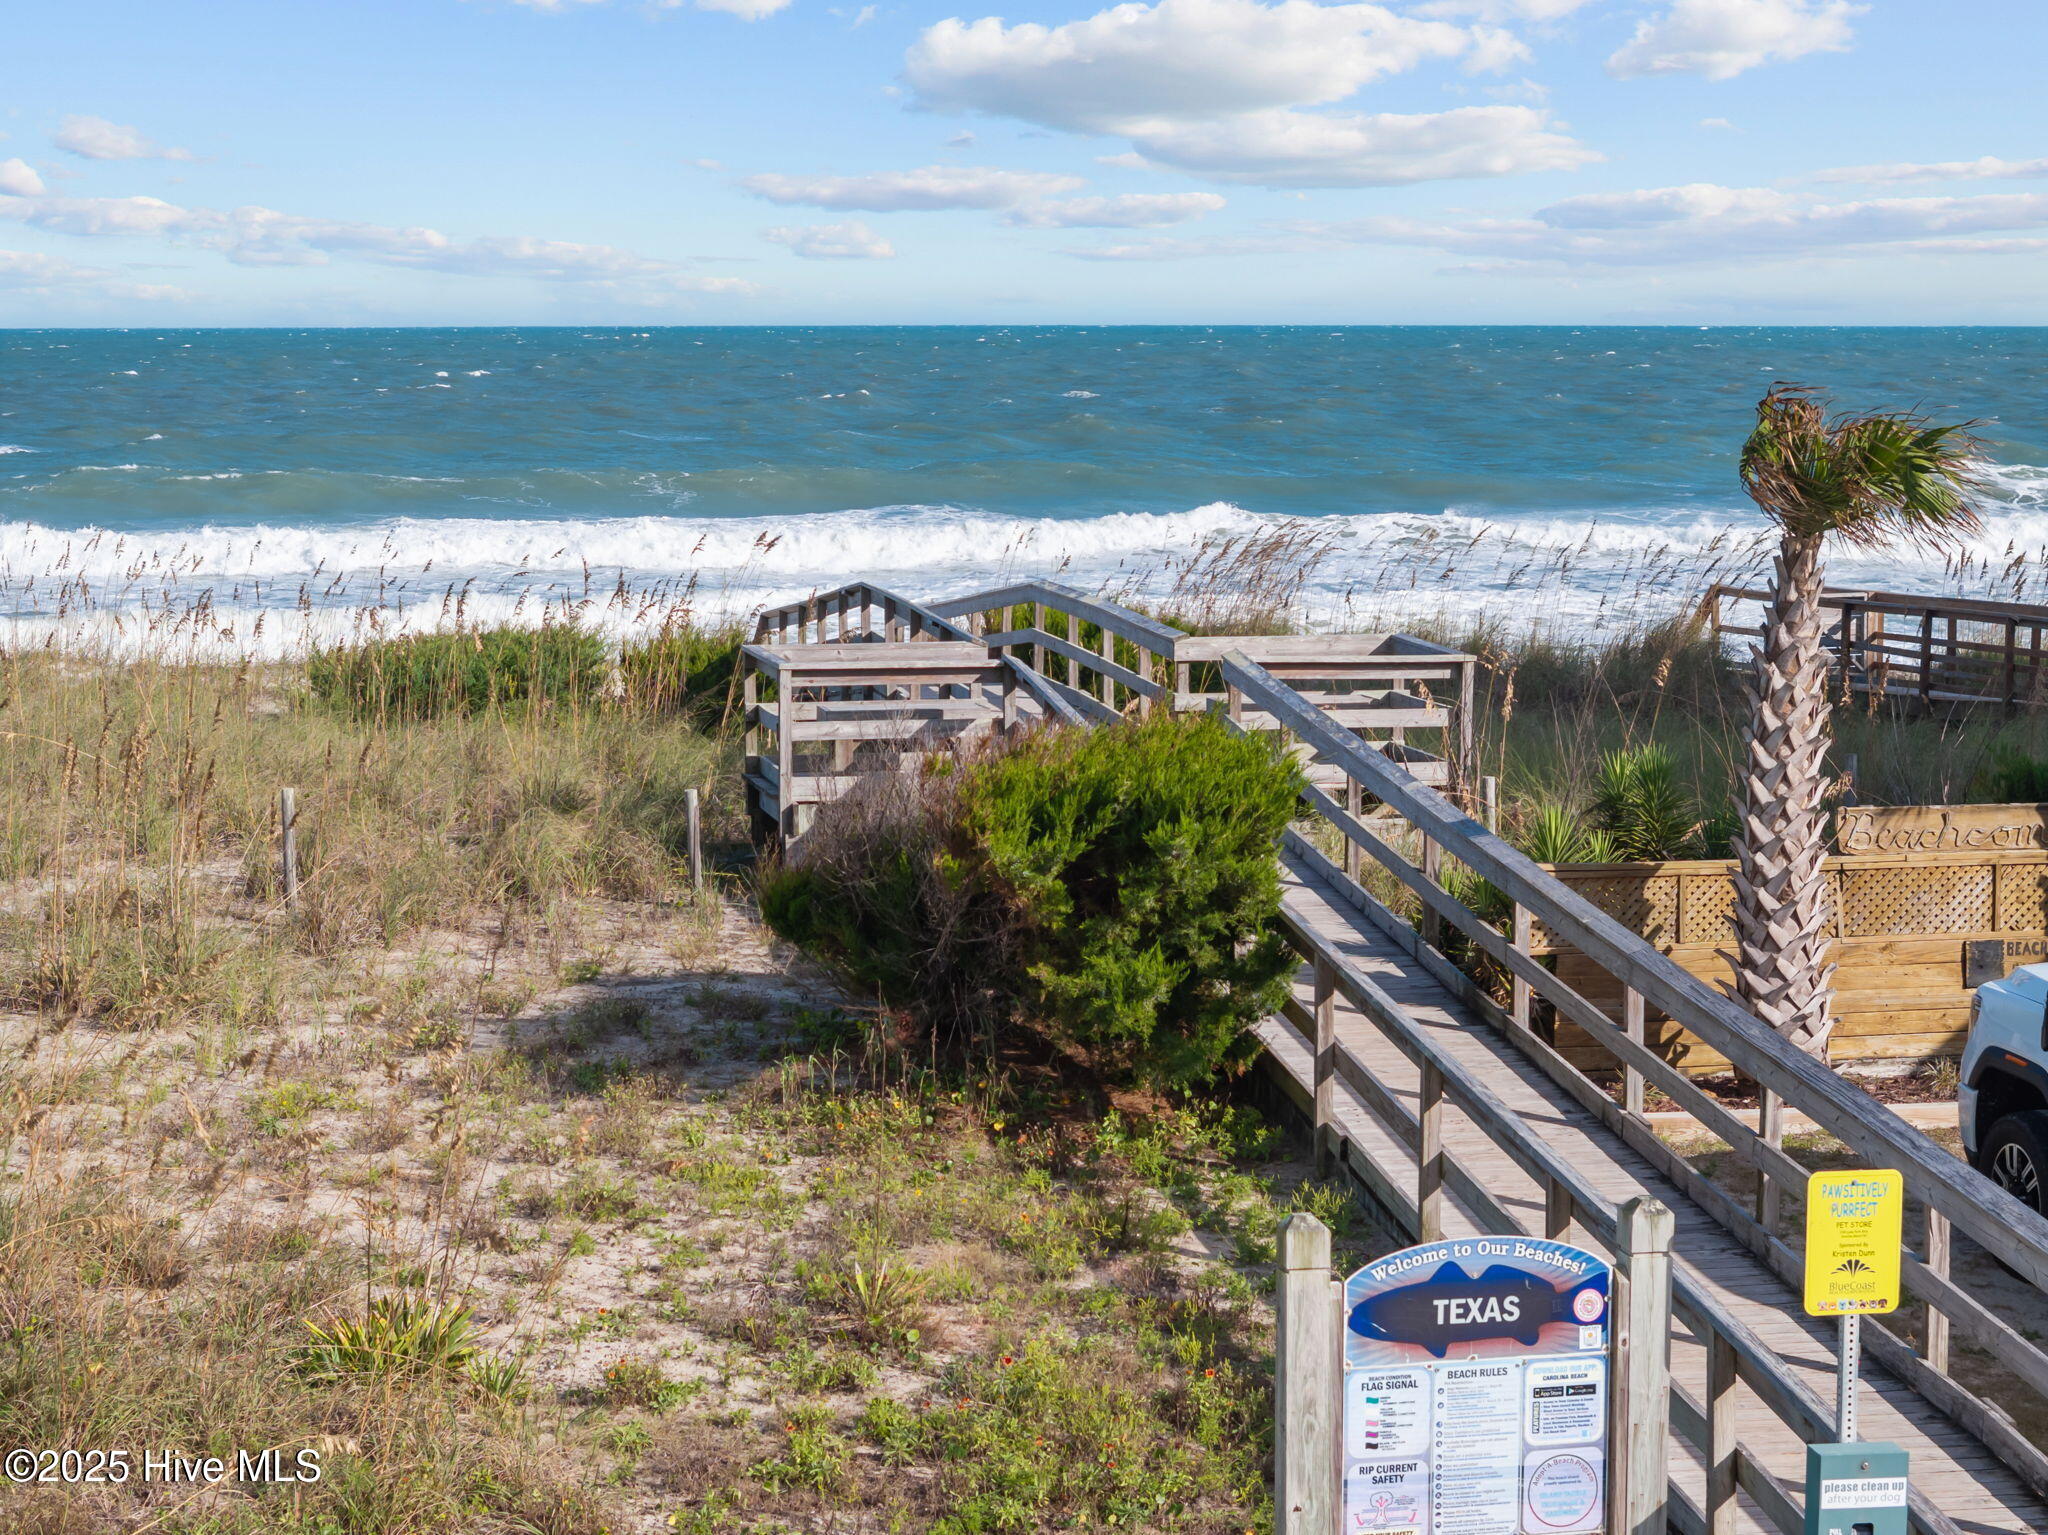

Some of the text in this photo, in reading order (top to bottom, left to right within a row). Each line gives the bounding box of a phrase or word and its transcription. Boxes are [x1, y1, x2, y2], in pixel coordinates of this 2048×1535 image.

[1822, 1182, 1888, 1198] PAWSITIVELY
[1831, 1202, 1878, 1217] PURRFECT
[1850, 1220, 1872, 1228] STORE
[1371, 1241, 1587, 1282] Welcome to Our Beaches!
[1433, 1295, 1520, 1325] TEXAS
[1447, 1367, 1508, 1379] BEACH RULES
[1361, 1380, 1419, 1391] FLAG SIGNAL
[1359, 1463, 1418, 1475] RIP CURRENT
[1372, 1474, 1405, 1485] SAFETY
[1824, 1481, 1905, 1493] please clean up
[1827, 1492, 1901, 1505] after your dog
